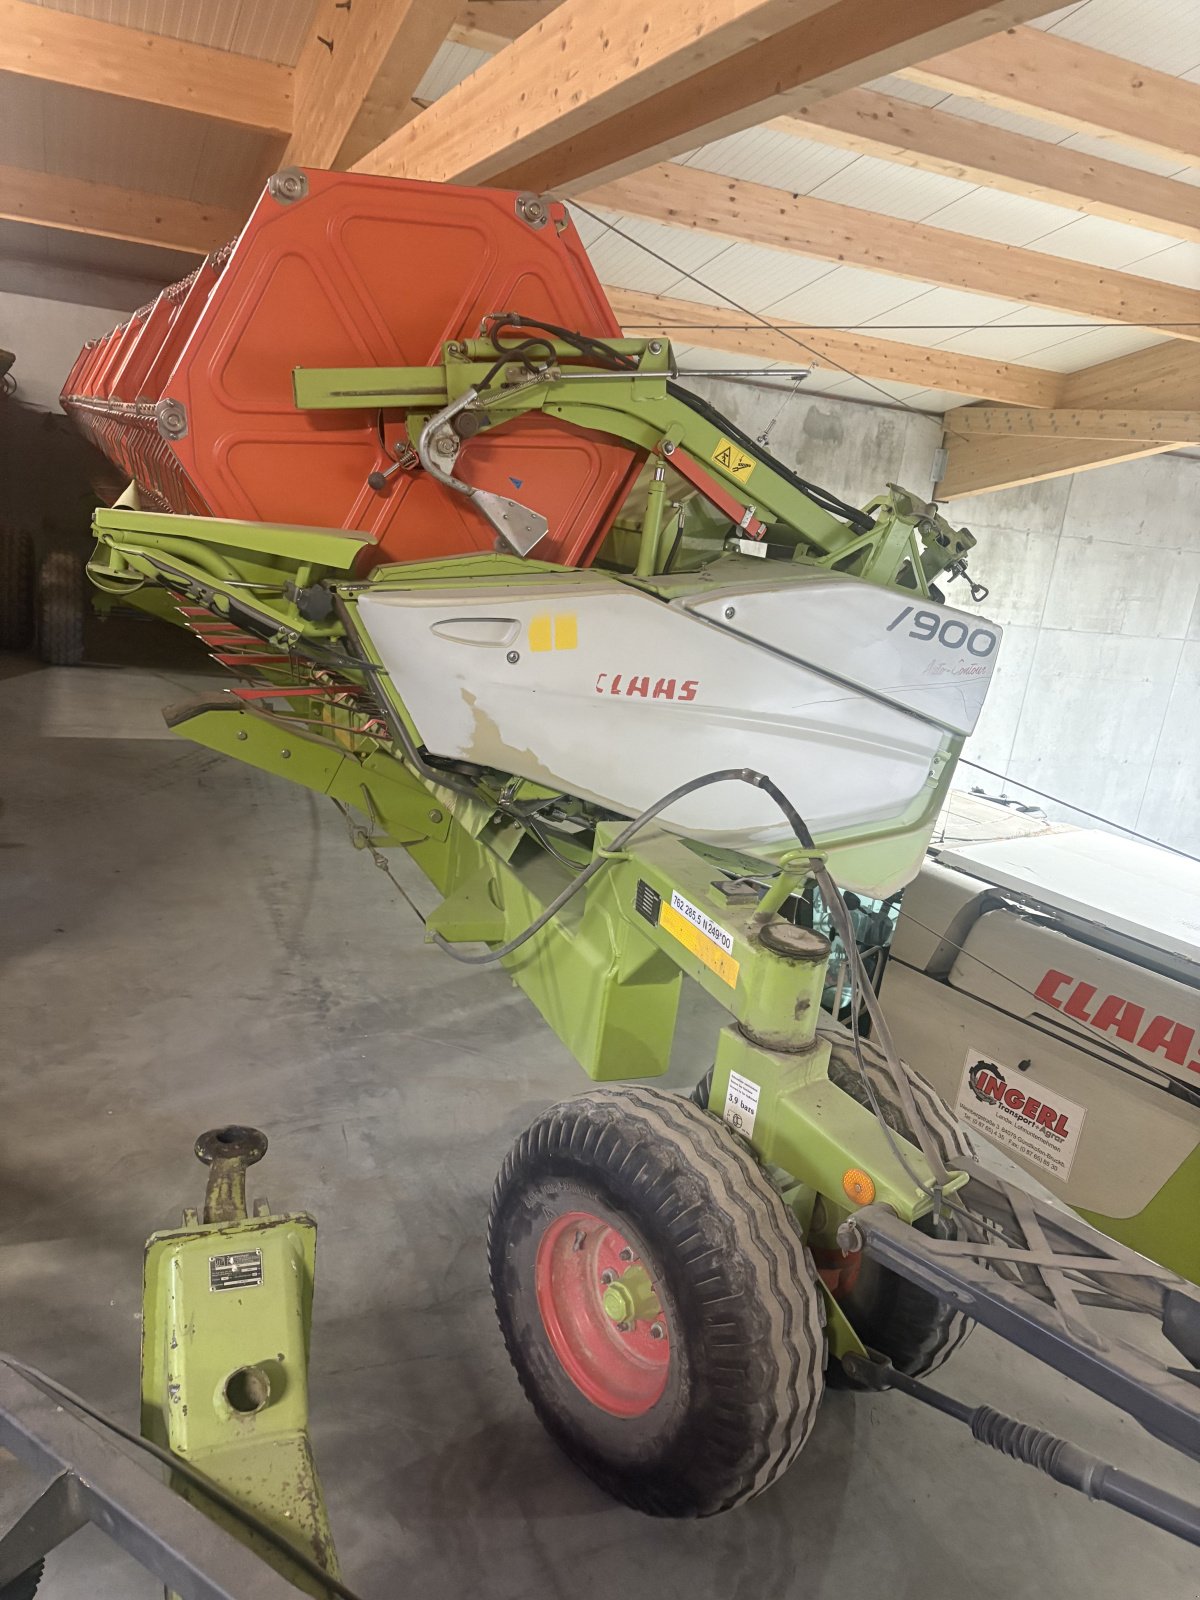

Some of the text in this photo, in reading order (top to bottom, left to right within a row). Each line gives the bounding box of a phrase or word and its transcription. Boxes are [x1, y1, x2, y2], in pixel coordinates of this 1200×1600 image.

[596, 673, 699, 701] CLAAS
[673, 895, 684, 911] 762
[728, 1093, 739, 1105] 3,9
[740, 1099, 755, 1115] bars
[975, 1071, 1069, 1138] INGERL
